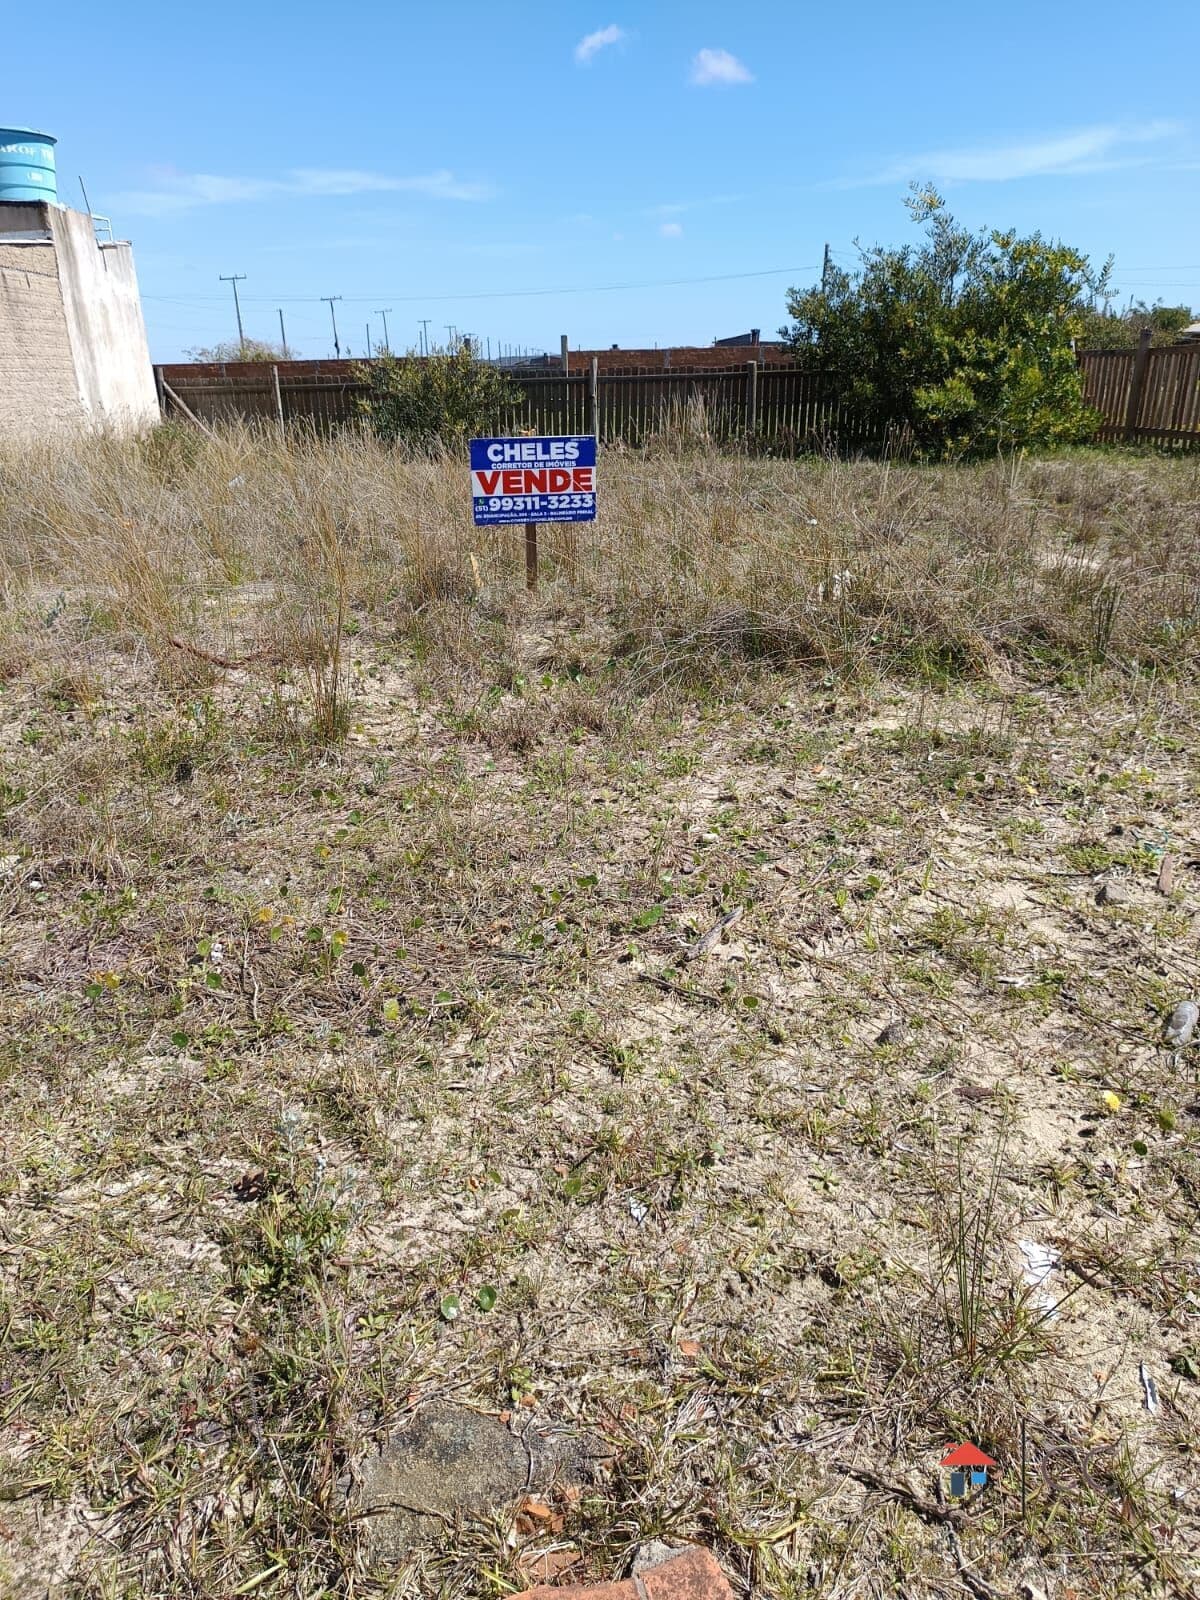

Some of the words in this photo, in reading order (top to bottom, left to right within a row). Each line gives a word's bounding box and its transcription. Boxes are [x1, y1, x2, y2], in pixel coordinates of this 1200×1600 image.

[487, 442, 580, 462] CHELES
[491, 462, 532, 470] CORRETOR
[545, 460, 577, 468] IMÓVEIS
[475, 468, 593, 495] VENDE
[488, 494, 594, 512] 99311-3233
